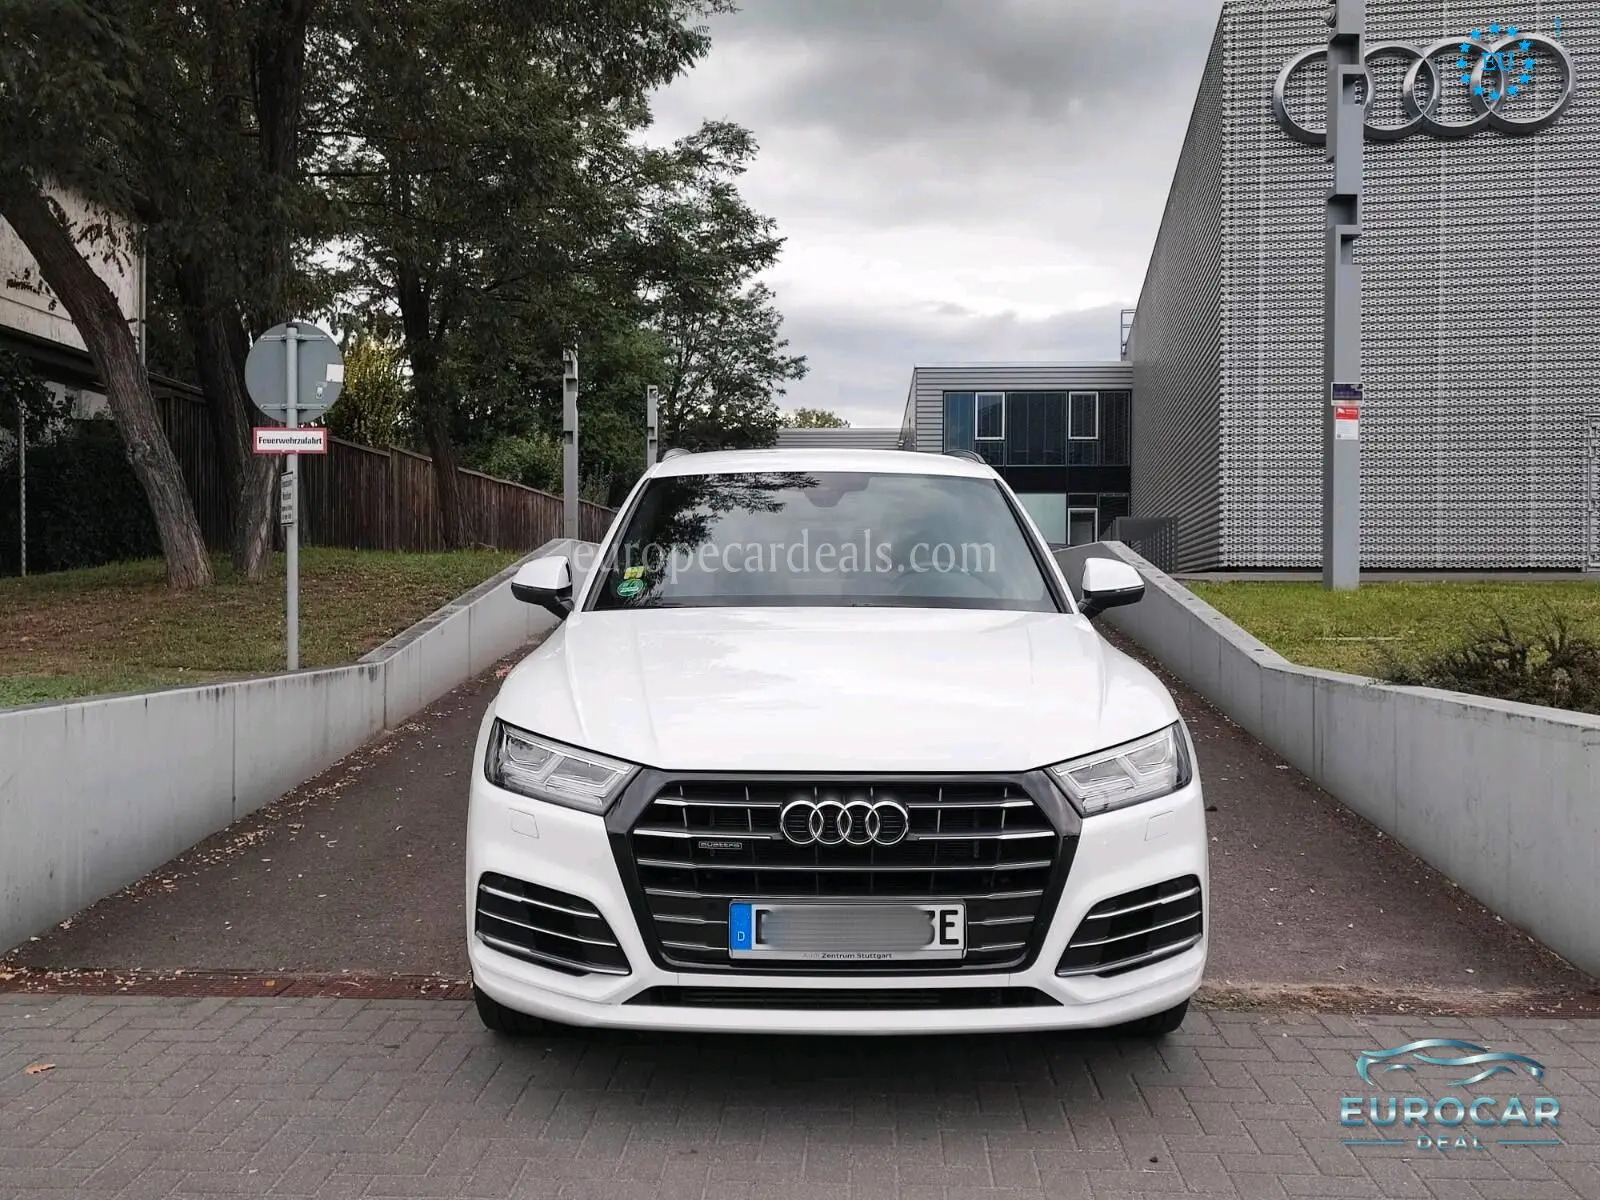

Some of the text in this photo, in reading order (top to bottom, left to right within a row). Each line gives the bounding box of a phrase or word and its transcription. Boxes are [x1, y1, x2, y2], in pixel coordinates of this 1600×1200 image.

[258, 436, 322, 445] Feuerwehrzufahrt
[737, 931, 745, 941] D
[821, 951, 855, 959] Zentrum
[856, 951, 893, 960] Stuttgart
